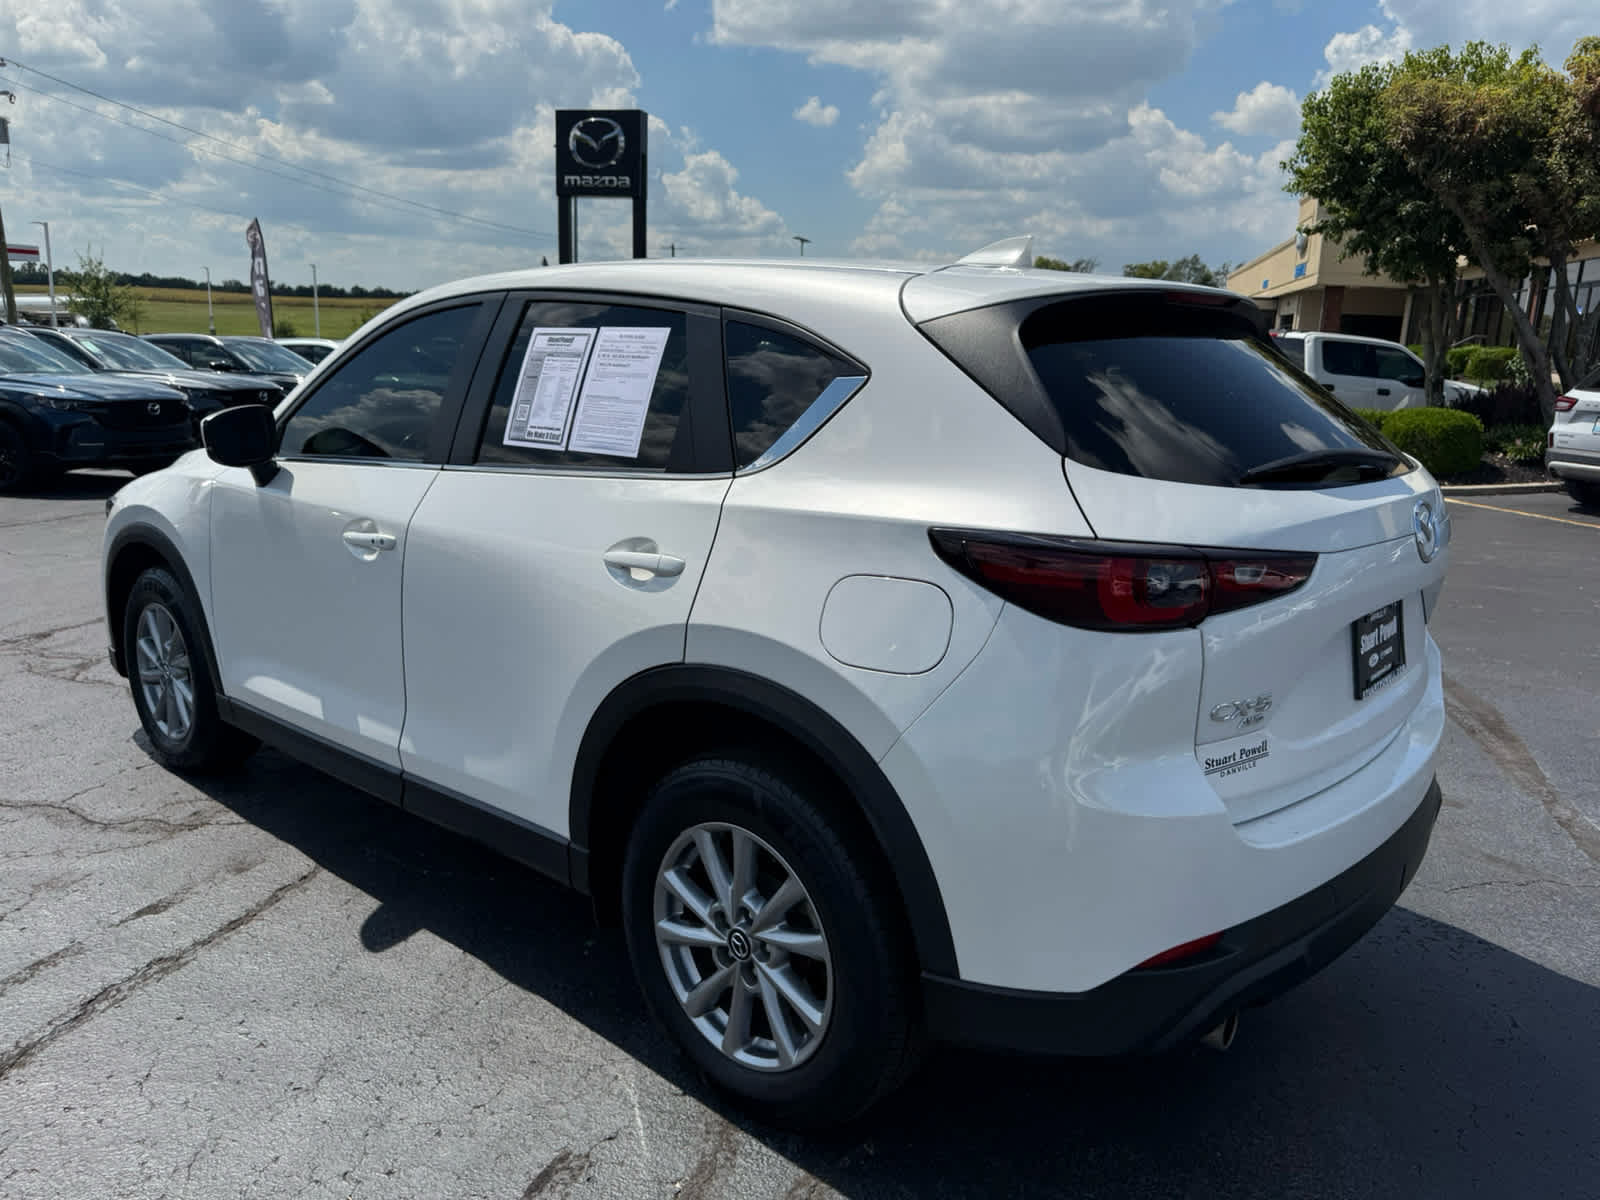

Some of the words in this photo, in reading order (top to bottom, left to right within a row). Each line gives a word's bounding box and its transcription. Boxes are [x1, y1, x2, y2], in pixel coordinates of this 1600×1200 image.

[564, 175, 630, 188] mazda
[1204, 752, 1237, 770] Stuart
[1239, 739, 1268, 760] Powell
[1219, 761, 1257, 778] DANVILLE
